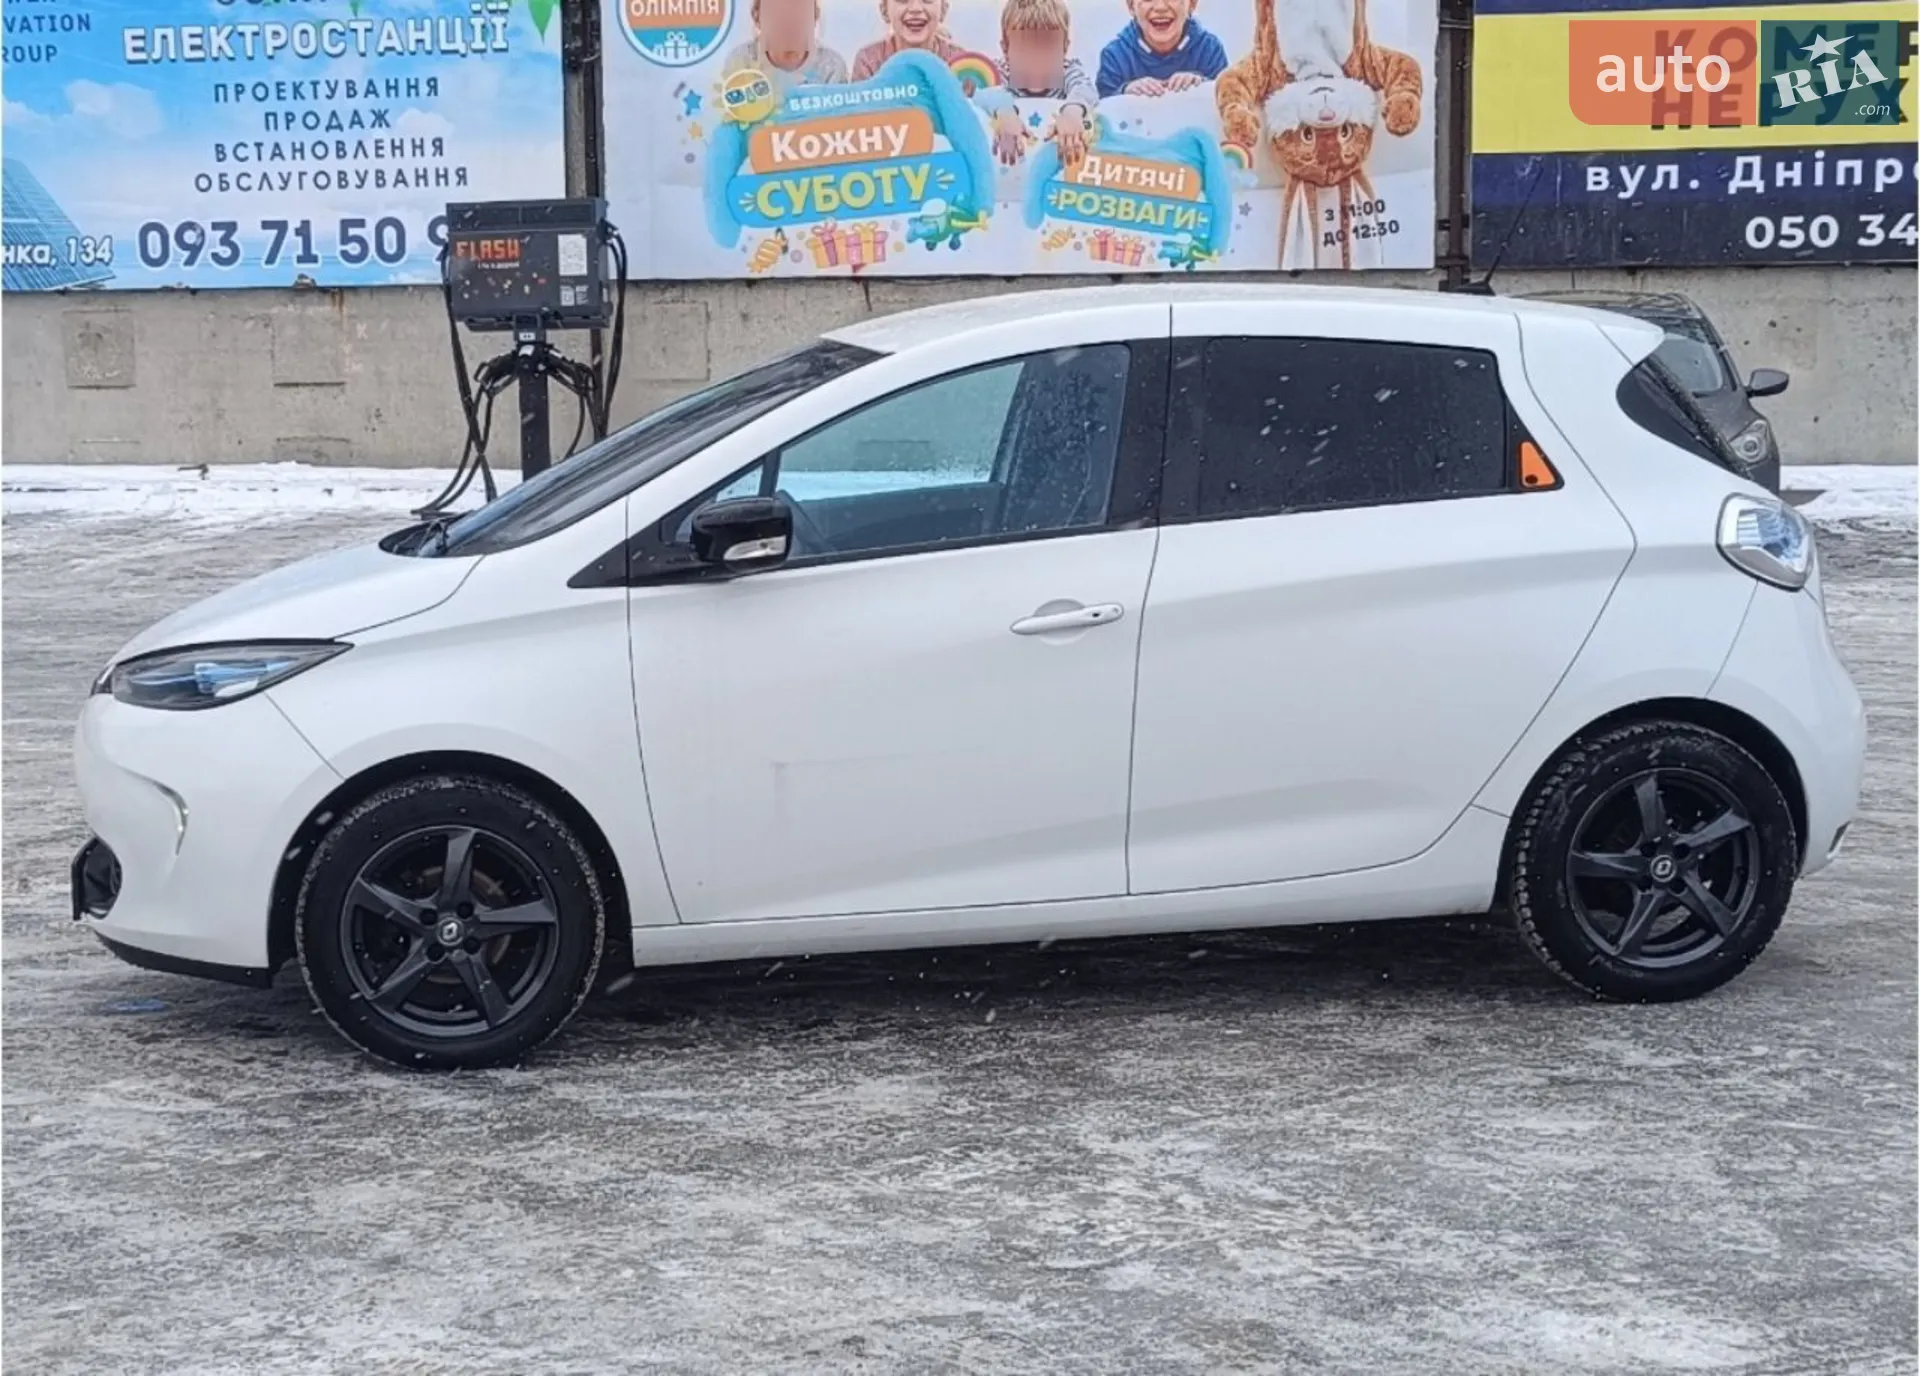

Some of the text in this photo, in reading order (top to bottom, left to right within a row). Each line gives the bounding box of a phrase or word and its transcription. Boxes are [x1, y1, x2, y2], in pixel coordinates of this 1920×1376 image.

[122, 2, 510, 64] ЕЛЕКТРОСТАНЦІЇ
[214, 77, 439, 103] ПРОЕКТУВАННЯ
[789, 84, 918, 111] БЕЗКОШТОВНО
[264, 109, 391, 132] ПРОДАЖ
[215, 137, 444, 162] ВСТАНОВЛЕННЯ
[771, 124, 909, 163] Кожну
[194, 166, 468, 193] ОБСЛУГОВУВАННЯ
[1077, 155, 1186, 191] Дитячі
[1727, 150, 1918, 195] Дніпр
[757, 163, 931, 220] СУБОТУ
[1057, 188, 1196, 230] РОЗВАГИ
[138, 220, 241, 267] 093
[261, 219, 319, 265] 71
[340, 217, 406, 264] 50
[1352, 219, 1400, 240] 12:30
[1745, 212, 1918, 249] 050 34
[66, 235, 114, 266] 134
[456, 238, 519, 261] FLASH
